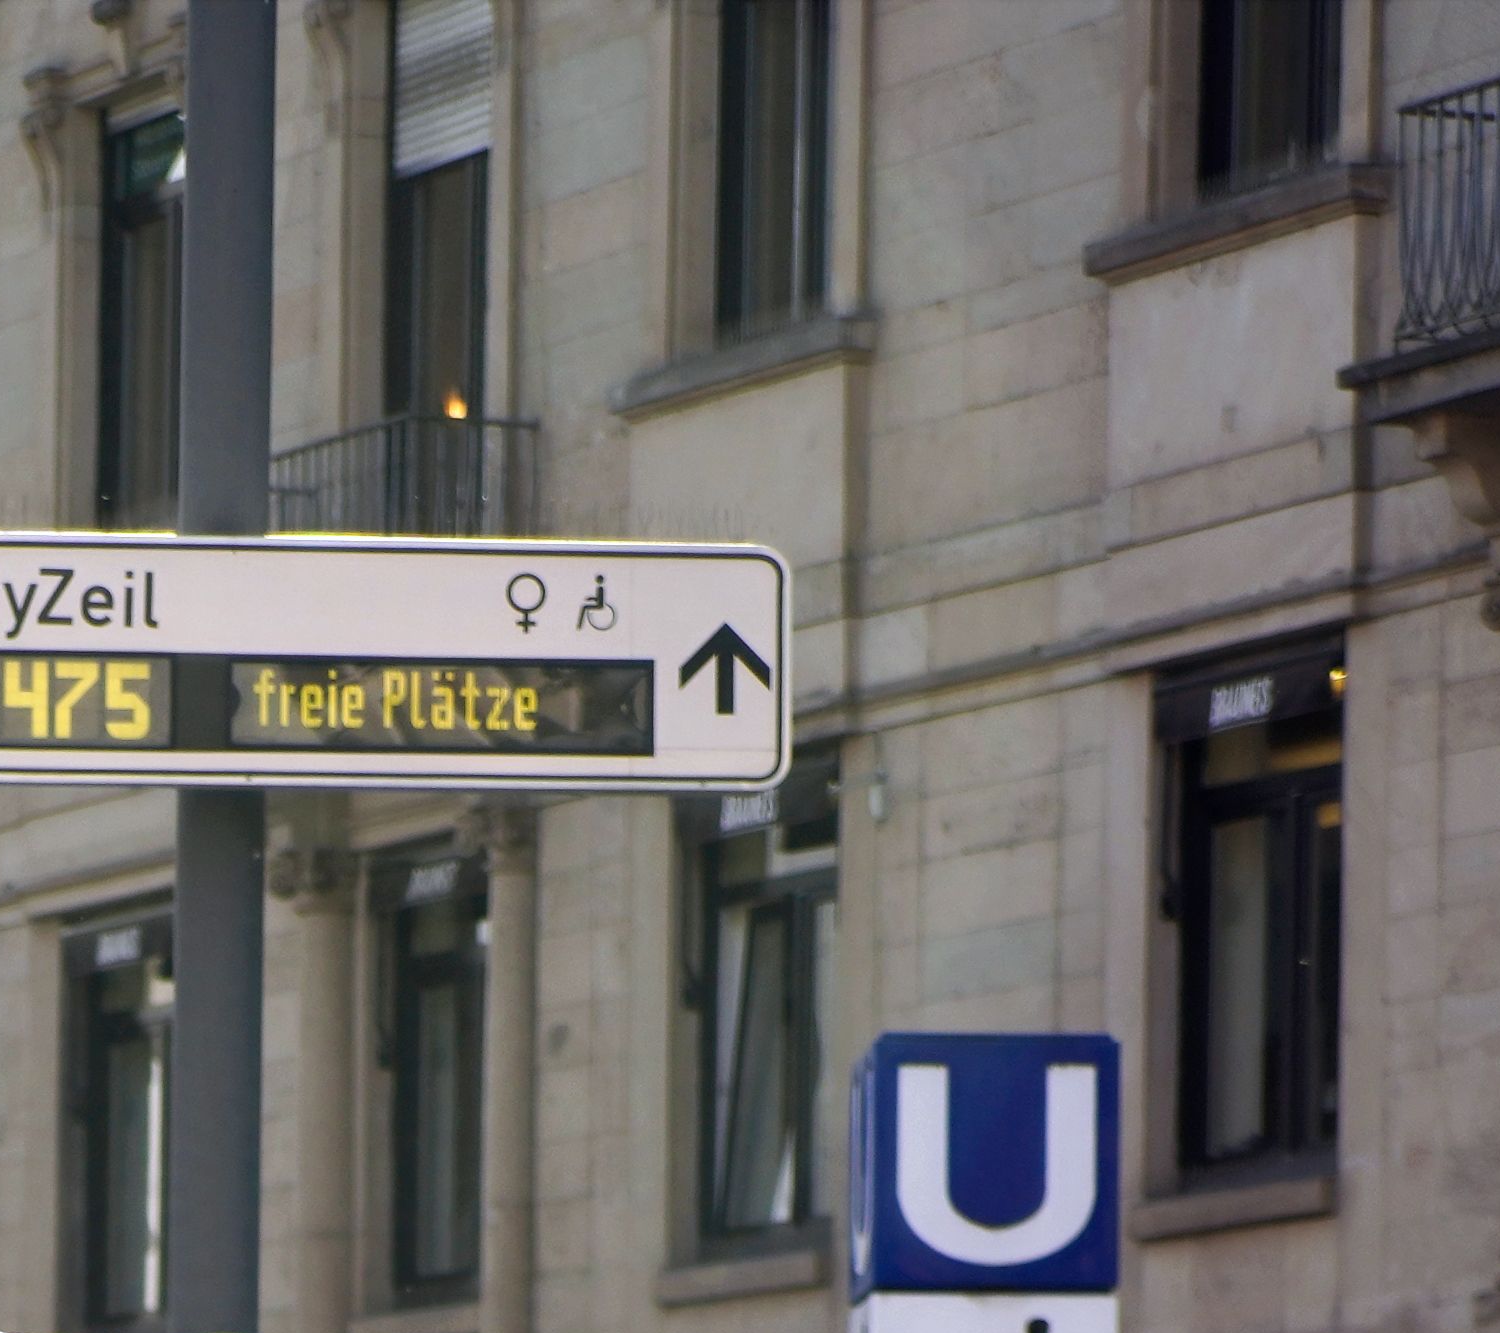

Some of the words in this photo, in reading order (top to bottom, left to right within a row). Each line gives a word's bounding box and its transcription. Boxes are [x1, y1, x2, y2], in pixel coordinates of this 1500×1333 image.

[4, 660, 152, 740] 475
[253, 668, 365, 730] freie
[381, 668, 539, 731] Plätze
[896, 1064, 1098, 1267] U
